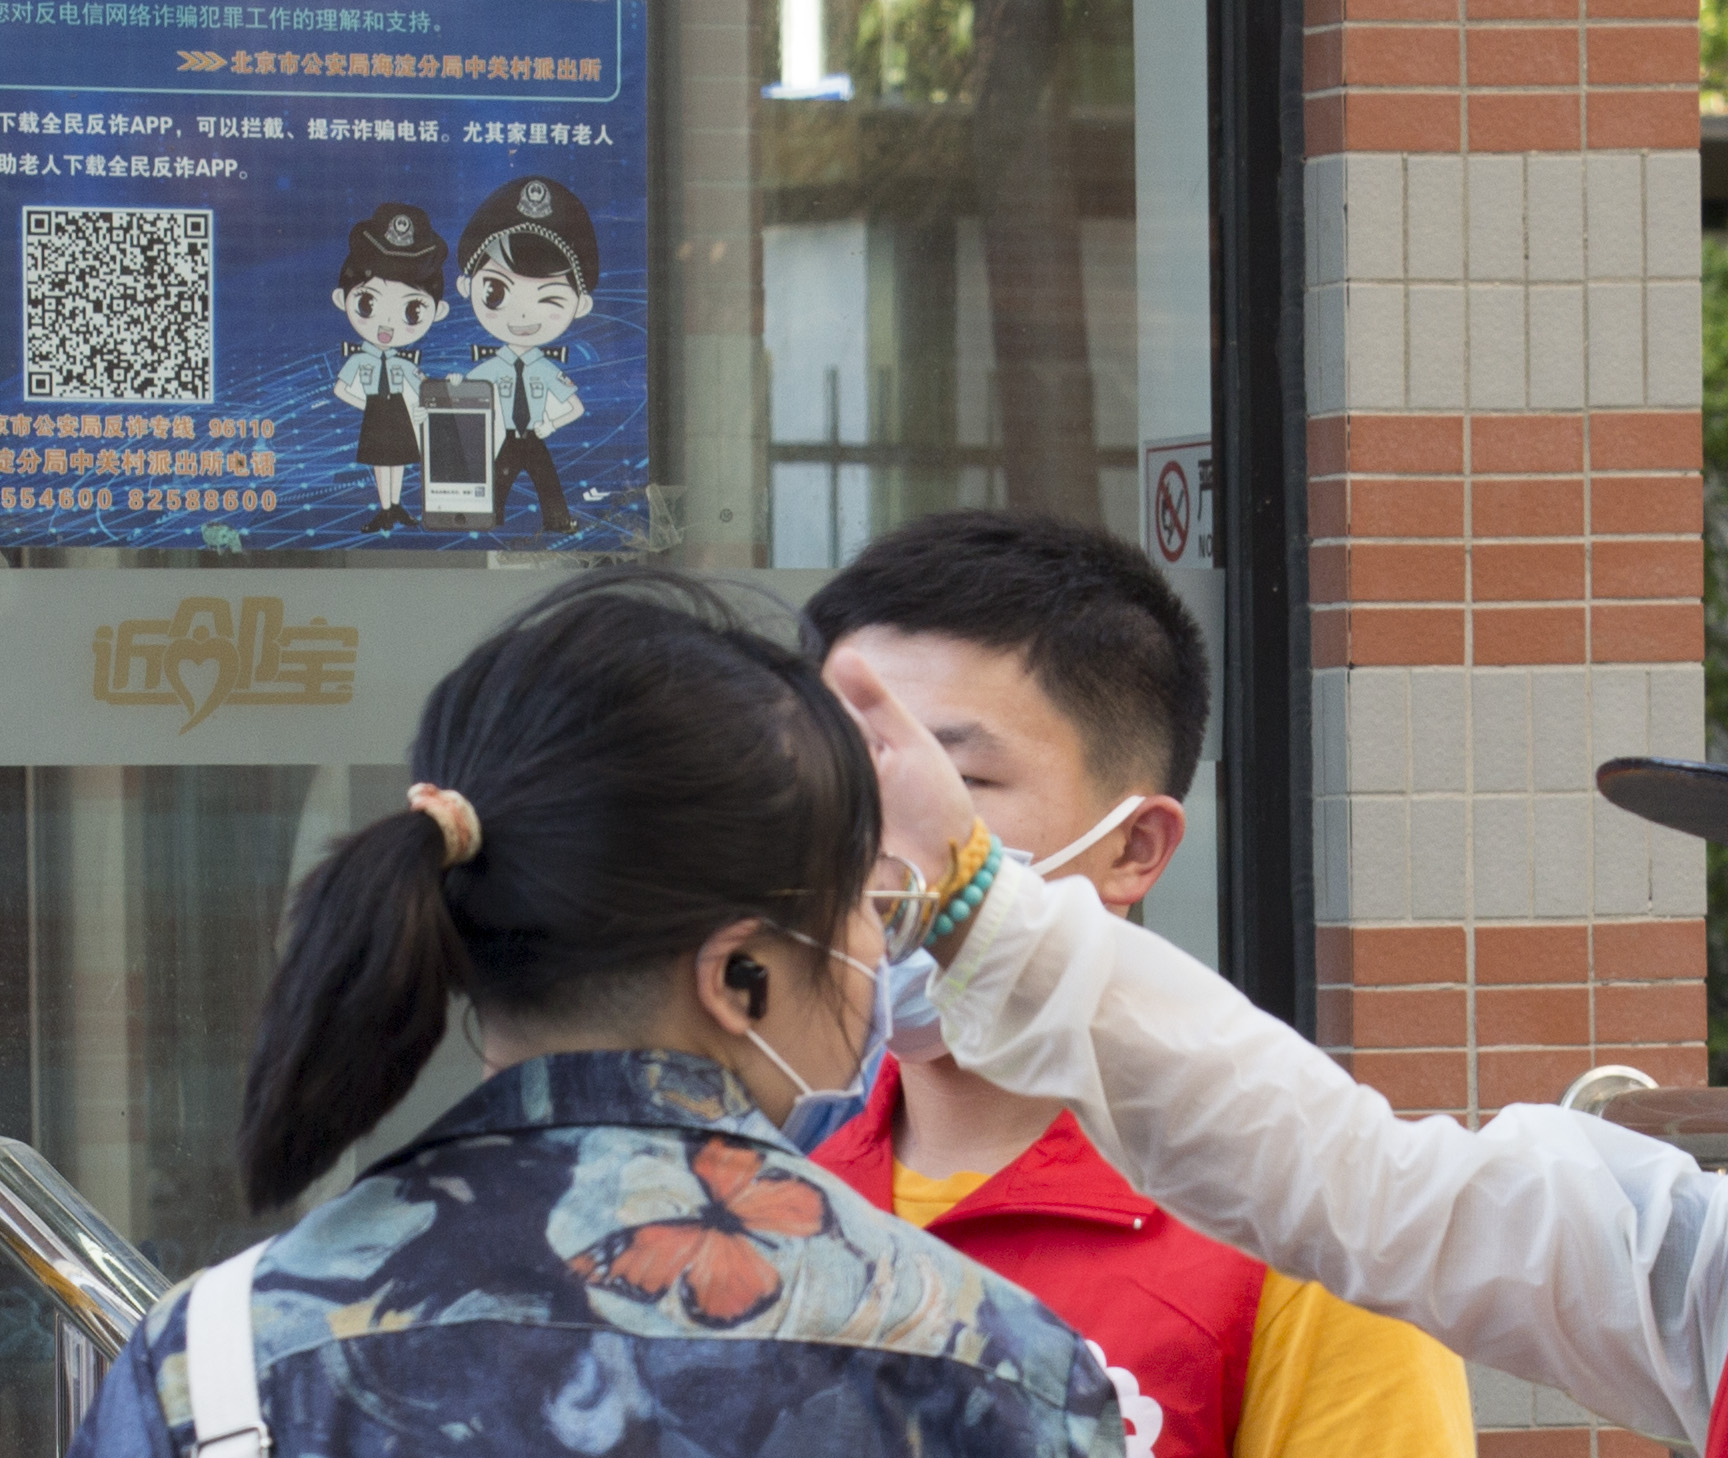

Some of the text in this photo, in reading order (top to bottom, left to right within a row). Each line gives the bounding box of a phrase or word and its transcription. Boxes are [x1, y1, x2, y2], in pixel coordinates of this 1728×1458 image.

[231, 51, 602, 81] 北京市公安局海淀分局中关村派出所
[208, 419, 275, 439] 96110
[128, 489, 277, 512] 82588600
